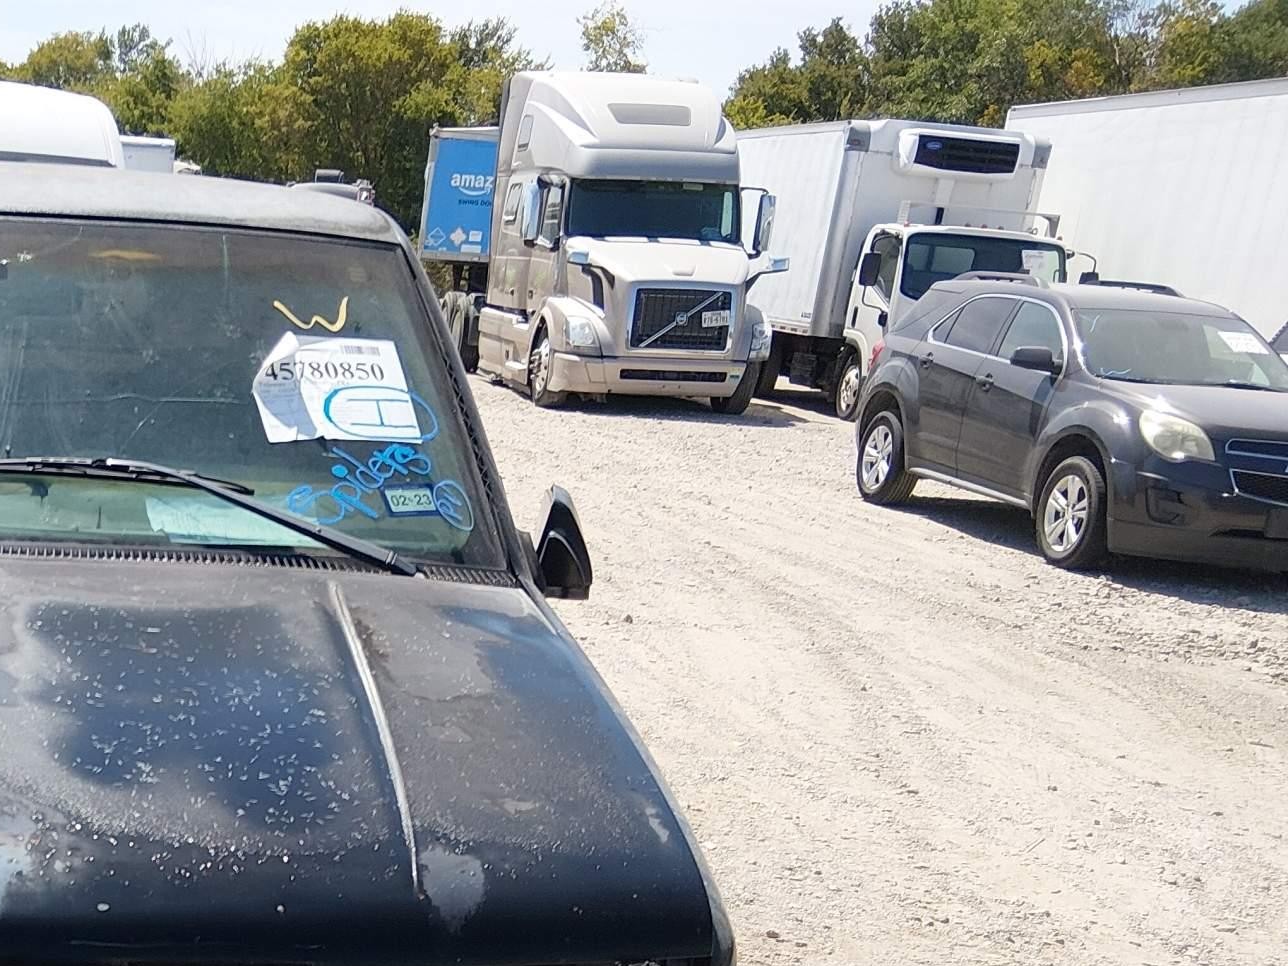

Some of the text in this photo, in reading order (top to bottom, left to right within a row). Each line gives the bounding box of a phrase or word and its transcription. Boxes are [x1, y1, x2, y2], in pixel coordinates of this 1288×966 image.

[451, 173, 494, 188] amaz
[272, 296, 349, 333] W
[264, 360, 385, 382] 45780850
